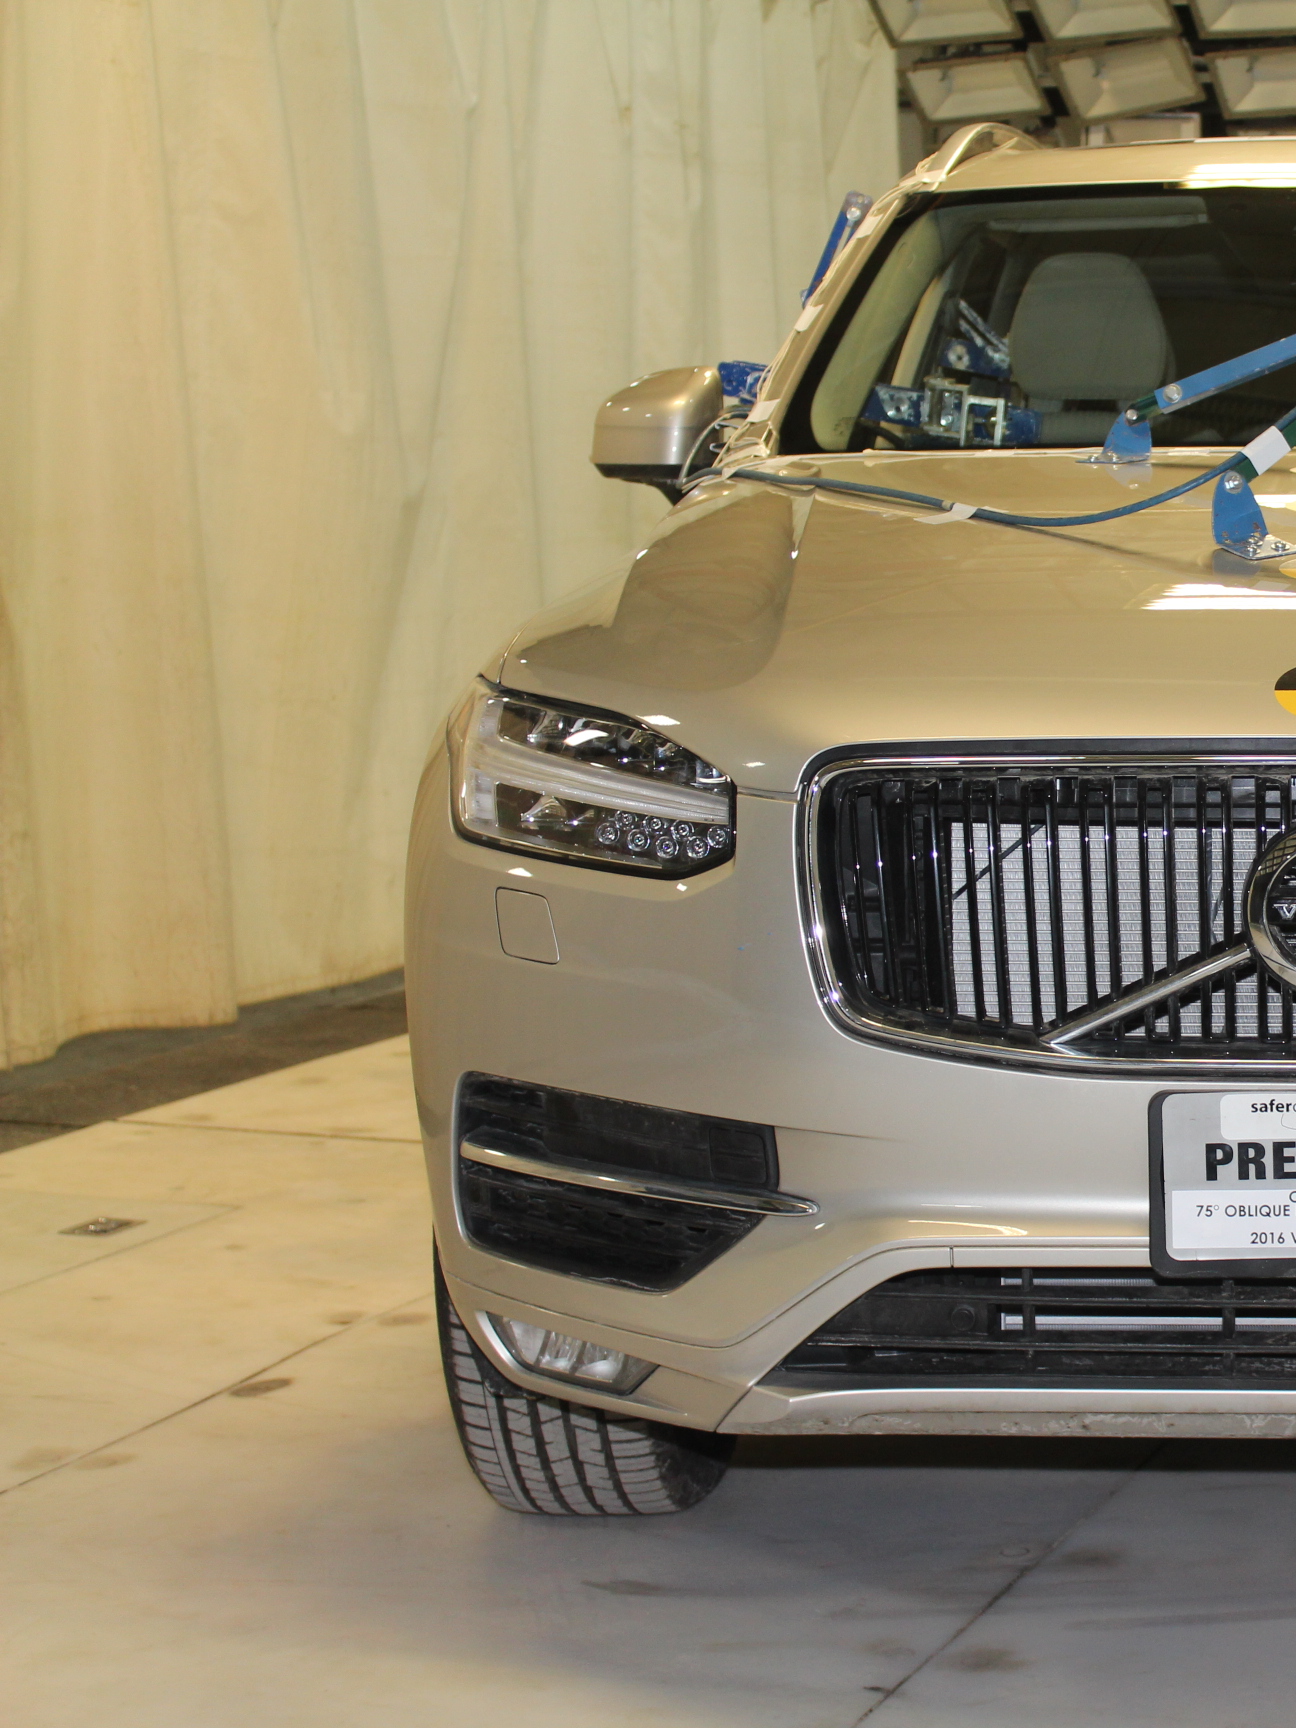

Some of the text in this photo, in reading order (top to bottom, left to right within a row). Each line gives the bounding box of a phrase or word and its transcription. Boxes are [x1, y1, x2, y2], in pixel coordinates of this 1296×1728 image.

[1196, 1204, 1220, 1219] 75°
[1224, 1204, 1291, 1220] OBLIQUE
[1250, 1232, 1286, 1246] 2016
